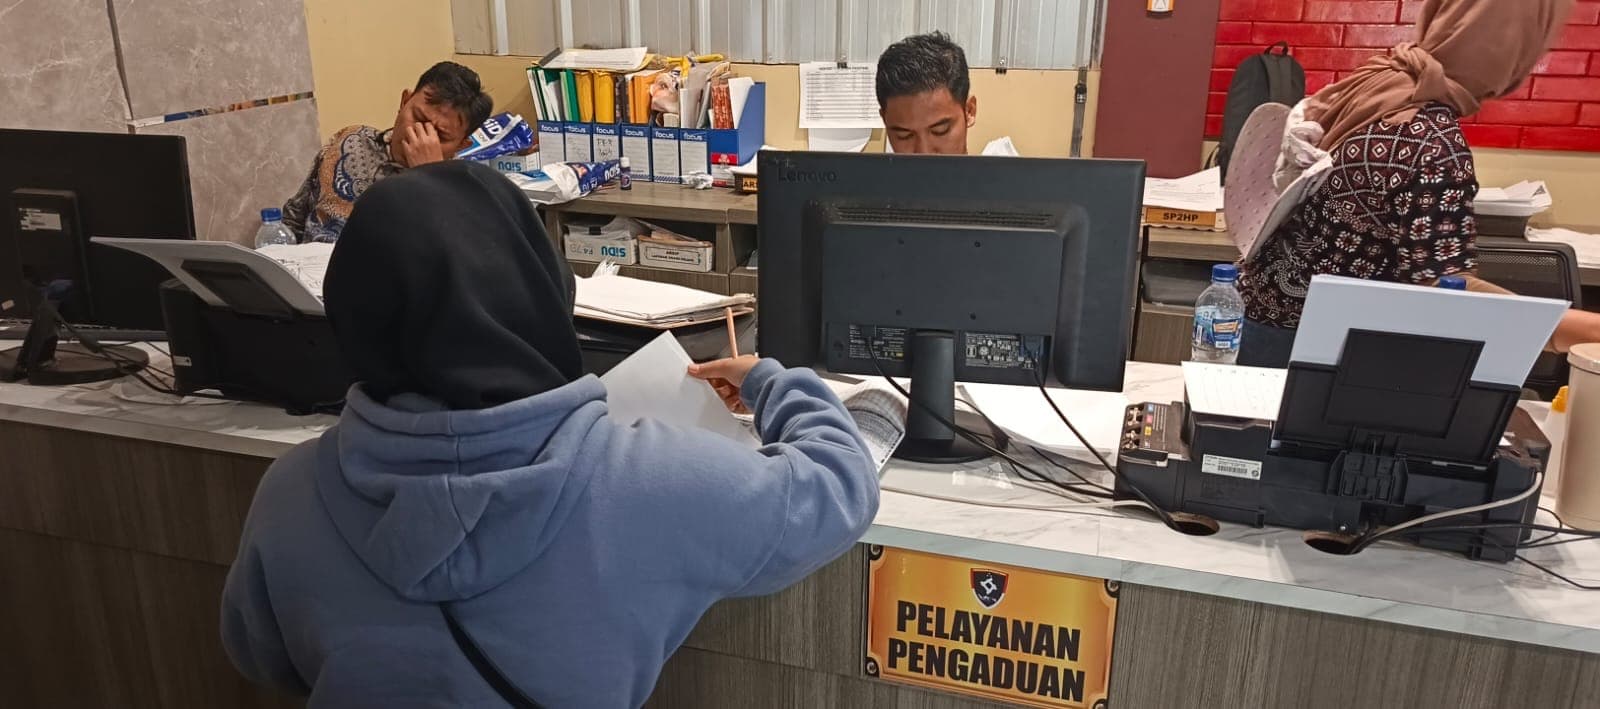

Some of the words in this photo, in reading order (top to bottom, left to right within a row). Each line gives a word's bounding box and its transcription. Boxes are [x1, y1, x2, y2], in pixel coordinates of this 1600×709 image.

[541, 124, 559, 132] focus
[568, 125, 586, 133] focus
[596, 126, 615, 134] focus
[624, 128, 644, 136] focus
[655, 131, 675, 139] focus
[683, 132, 702, 140] focus
[778, 168, 838, 183] Lenovo
[1163, 212, 1199, 222] SP2HP
[896, 600, 1081, 662] PELAYANAN
[887, 637, 1086, 702] PENGADUAN
